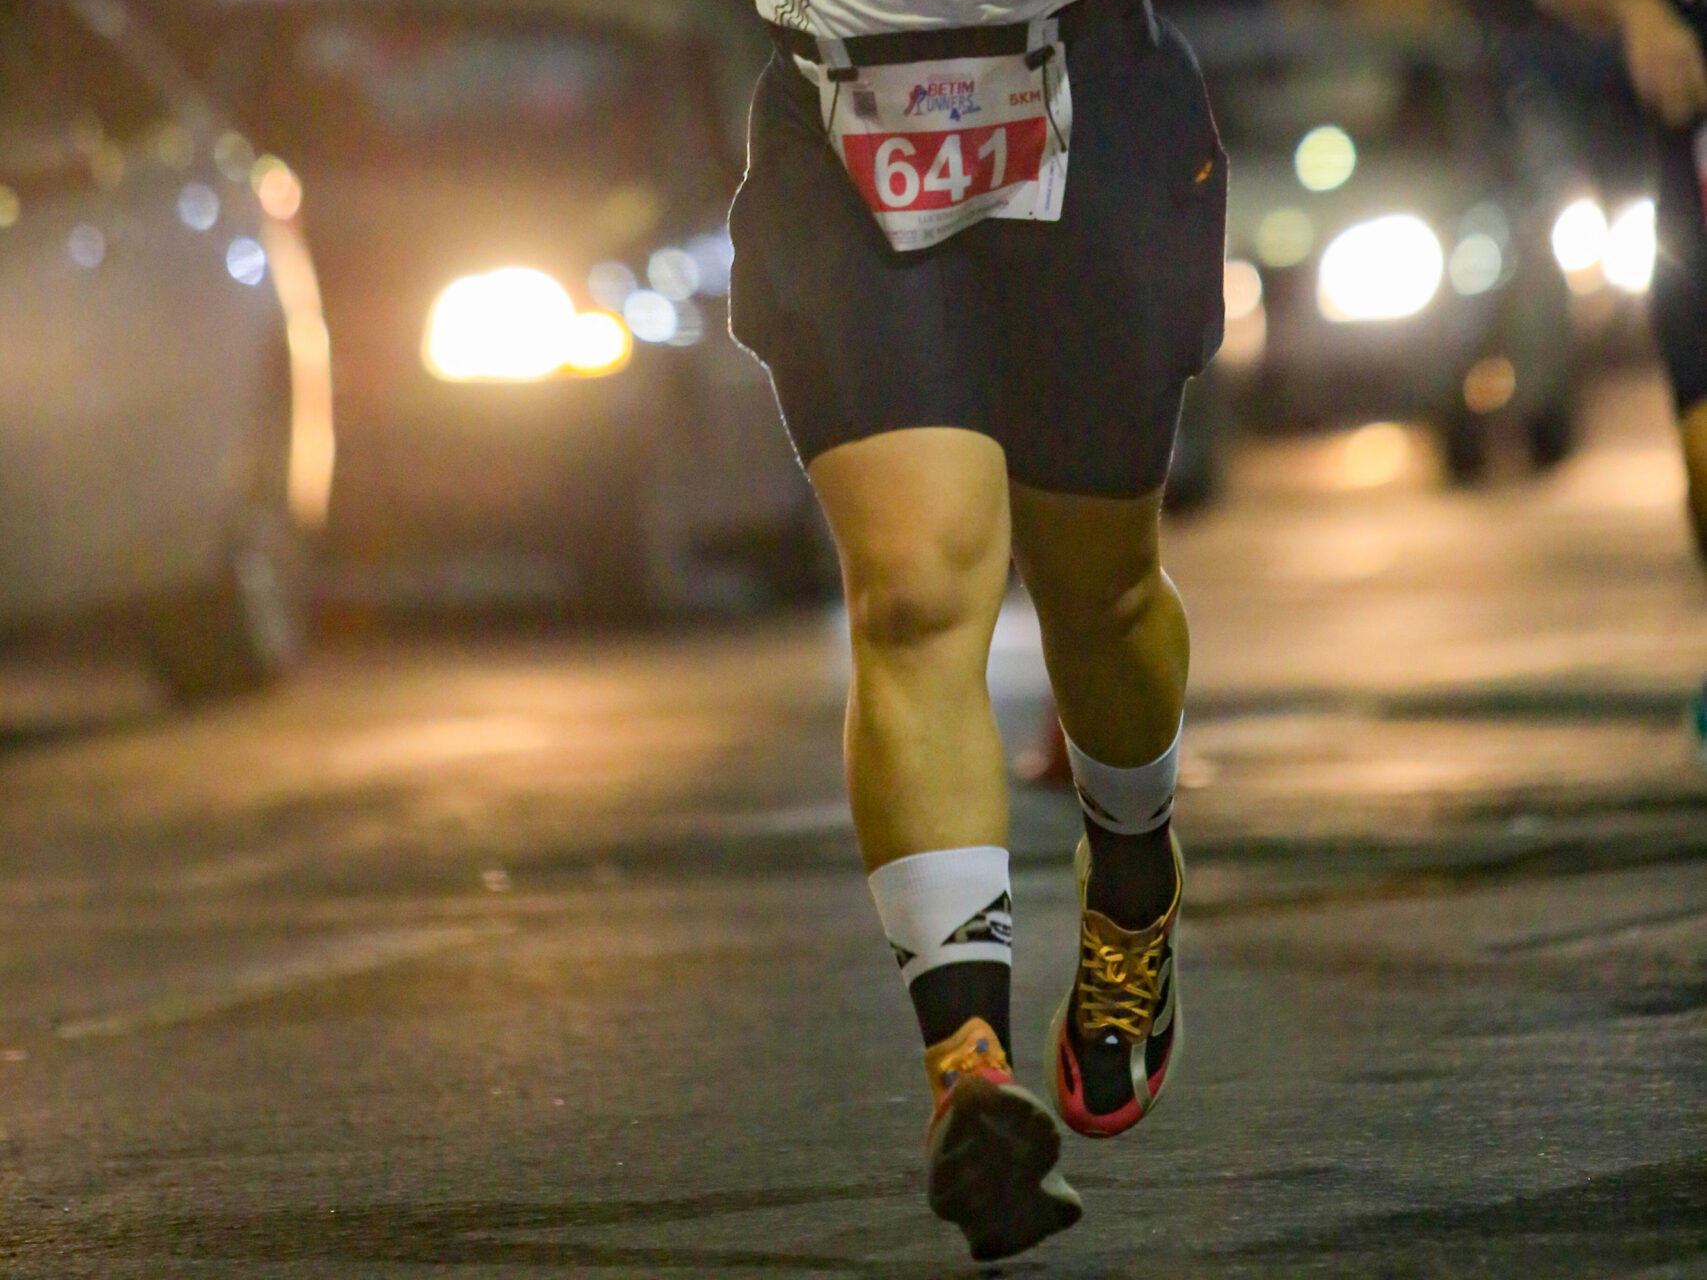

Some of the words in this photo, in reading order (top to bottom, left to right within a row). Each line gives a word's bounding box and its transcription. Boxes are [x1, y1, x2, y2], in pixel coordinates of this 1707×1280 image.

[927, 80, 975, 96] BETIM
[1009, 90, 1041, 106] 5KM
[874, 127, 1007, 208] 641
